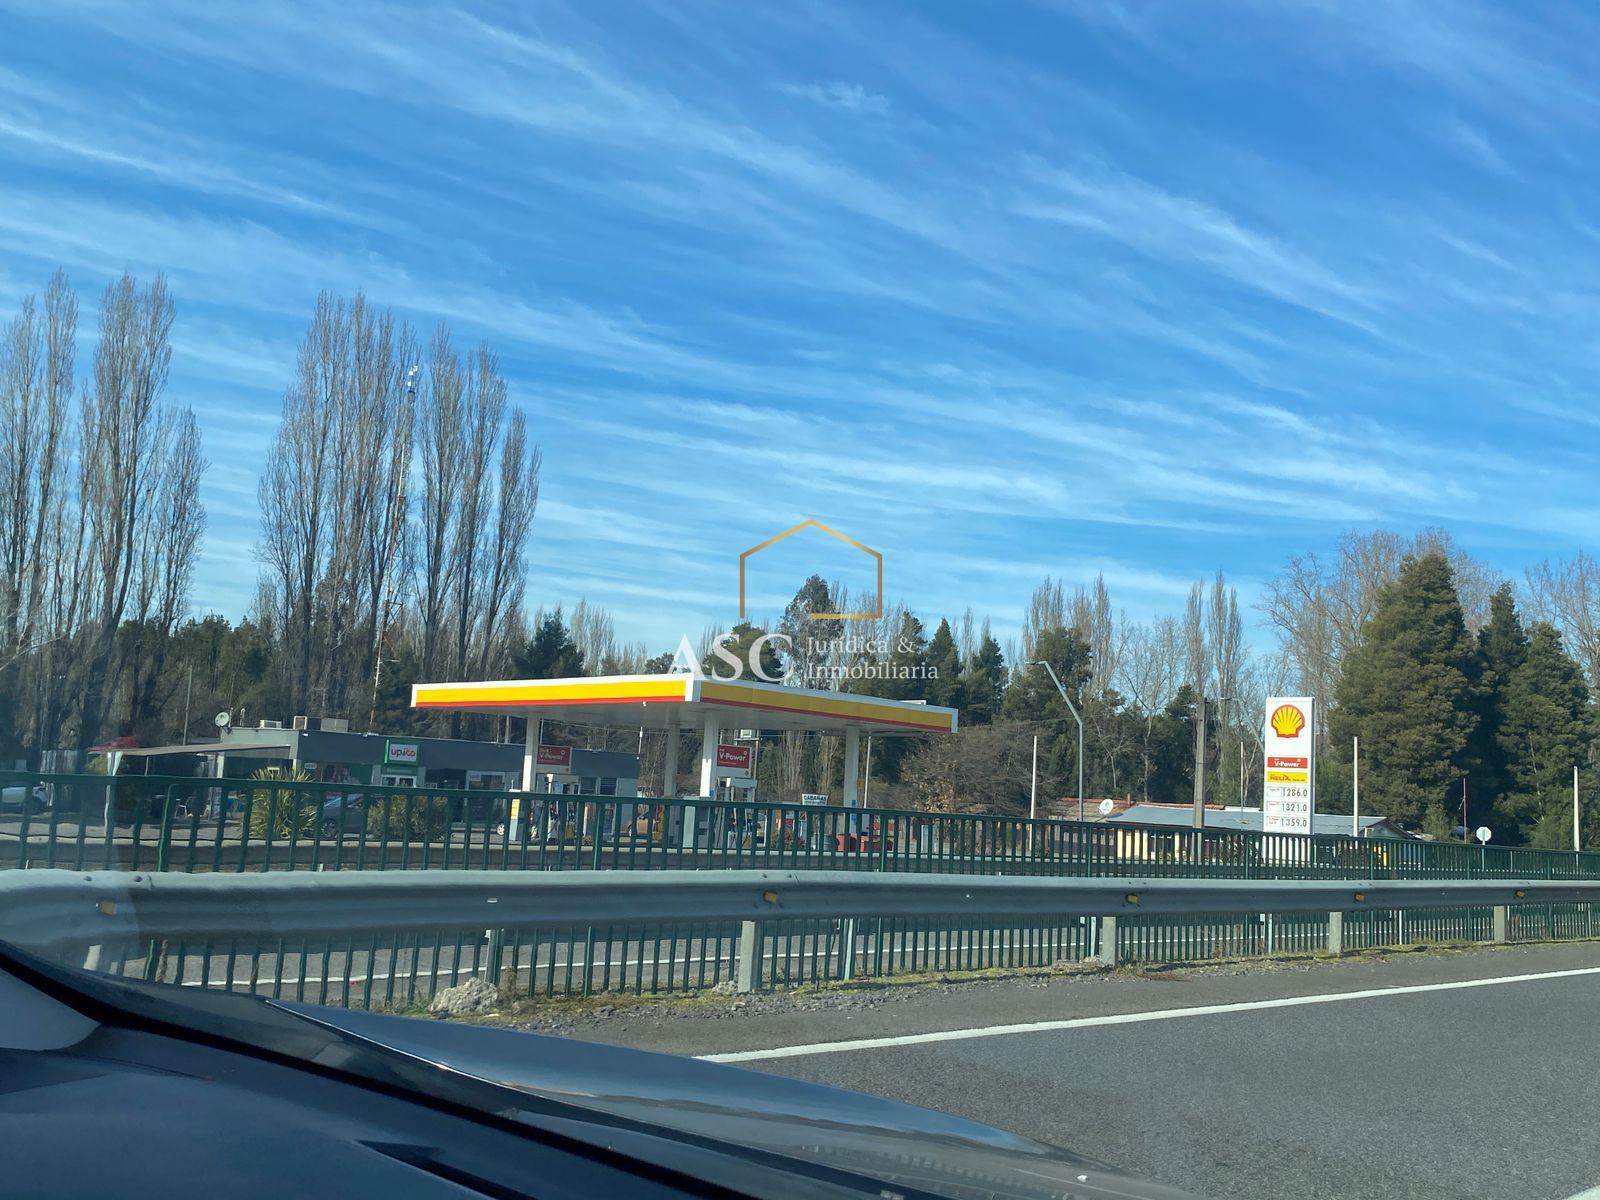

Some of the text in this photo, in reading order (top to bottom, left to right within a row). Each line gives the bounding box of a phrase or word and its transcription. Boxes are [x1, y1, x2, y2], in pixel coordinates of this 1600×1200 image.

[719, 752, 746, 762] V-Power
[1274, 760, 1300, 768] V-Power
[1282, 788, 1308, 797] 1286.0
[1282, 803, 1308, 812] 1321.0
[1281, 818, 1308, 828] 1359.0
